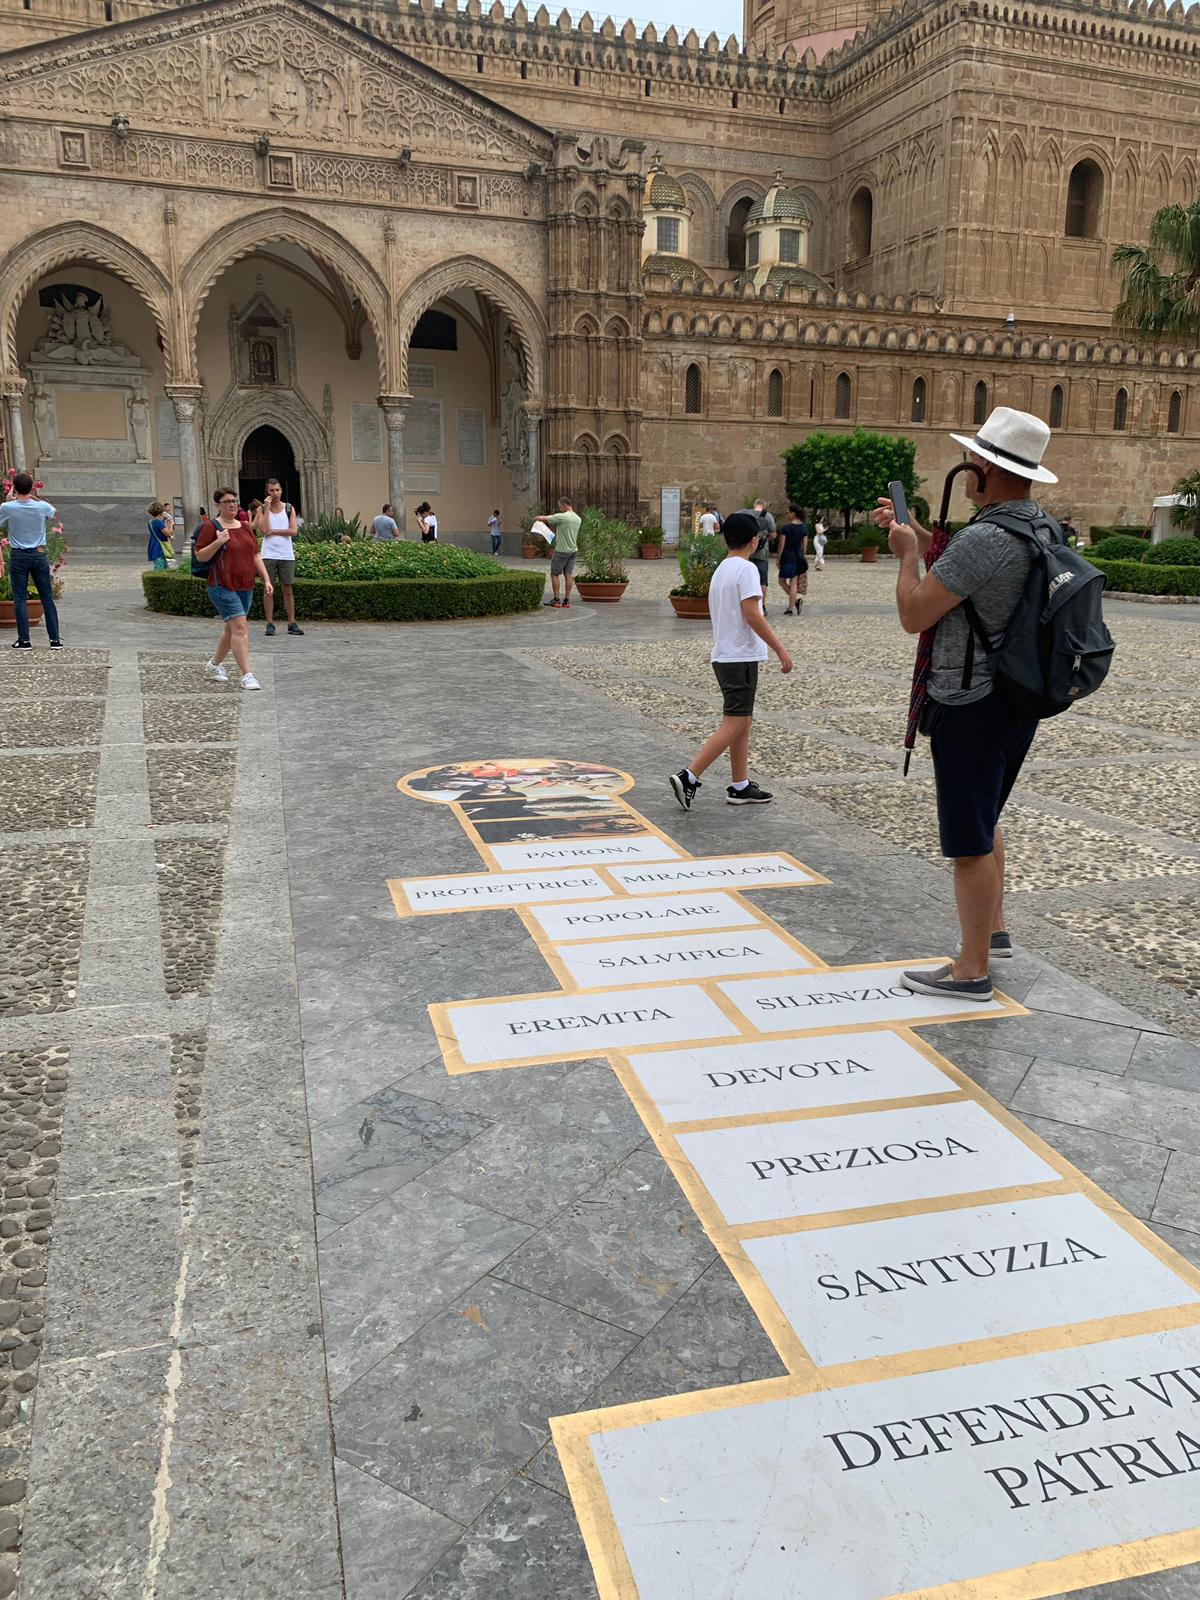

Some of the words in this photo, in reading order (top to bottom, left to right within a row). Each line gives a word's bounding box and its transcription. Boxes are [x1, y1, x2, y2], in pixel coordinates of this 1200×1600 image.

[525, 846, 641, 859] PATRONA
[622, 865, 793, 884] MIRACOLOSA
[415, 878, 599, 899] PROTETTRICE
[564, 905, 720, 925] POPOLARE
[598, 946, 766, 968] SALVIFICA
[507, 1008, 675, 1036] EREMITA
[703, 1058, 874, 1088] DEVOTA
[746, 1136, 979, 1181] PREZIOSA
[817, 1237, 1107, 1301] SANTUZZA
[823, 1383, 1135, 1471] DEFENDE
